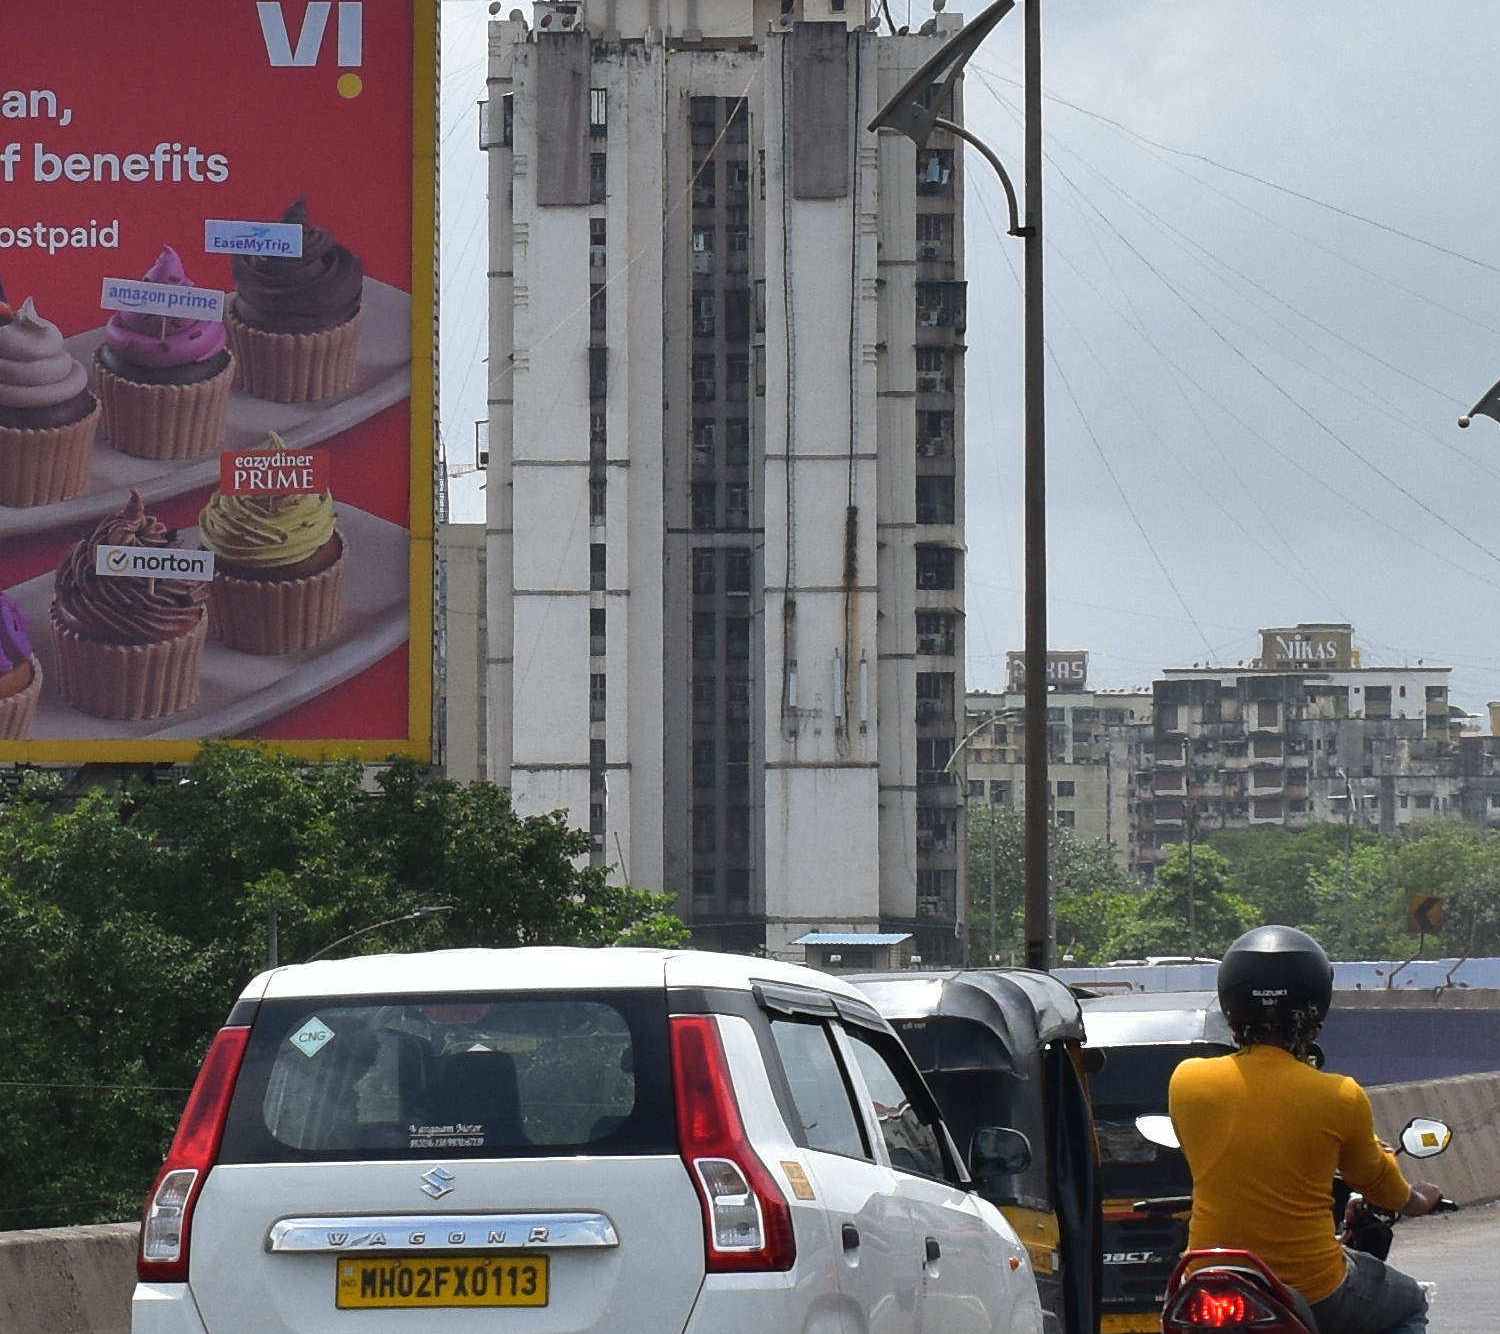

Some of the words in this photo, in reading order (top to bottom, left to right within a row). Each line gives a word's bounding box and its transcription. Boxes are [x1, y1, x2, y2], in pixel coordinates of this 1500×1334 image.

[33, 142, 229, 183] benefits
[213, 236, 291, 254] EaseMyTrip
[109, 285, 166, 303] amazon
[168, 292, 218, 310] prime
[235, 453, 313, 470] eazydiner
[233, 468, 314, 490] PRIME
[132, 553, 204, 573] norton
[298, 1030, 326, 1044] CNG
[360, 1267, 537, 1299] MH02FX0113
